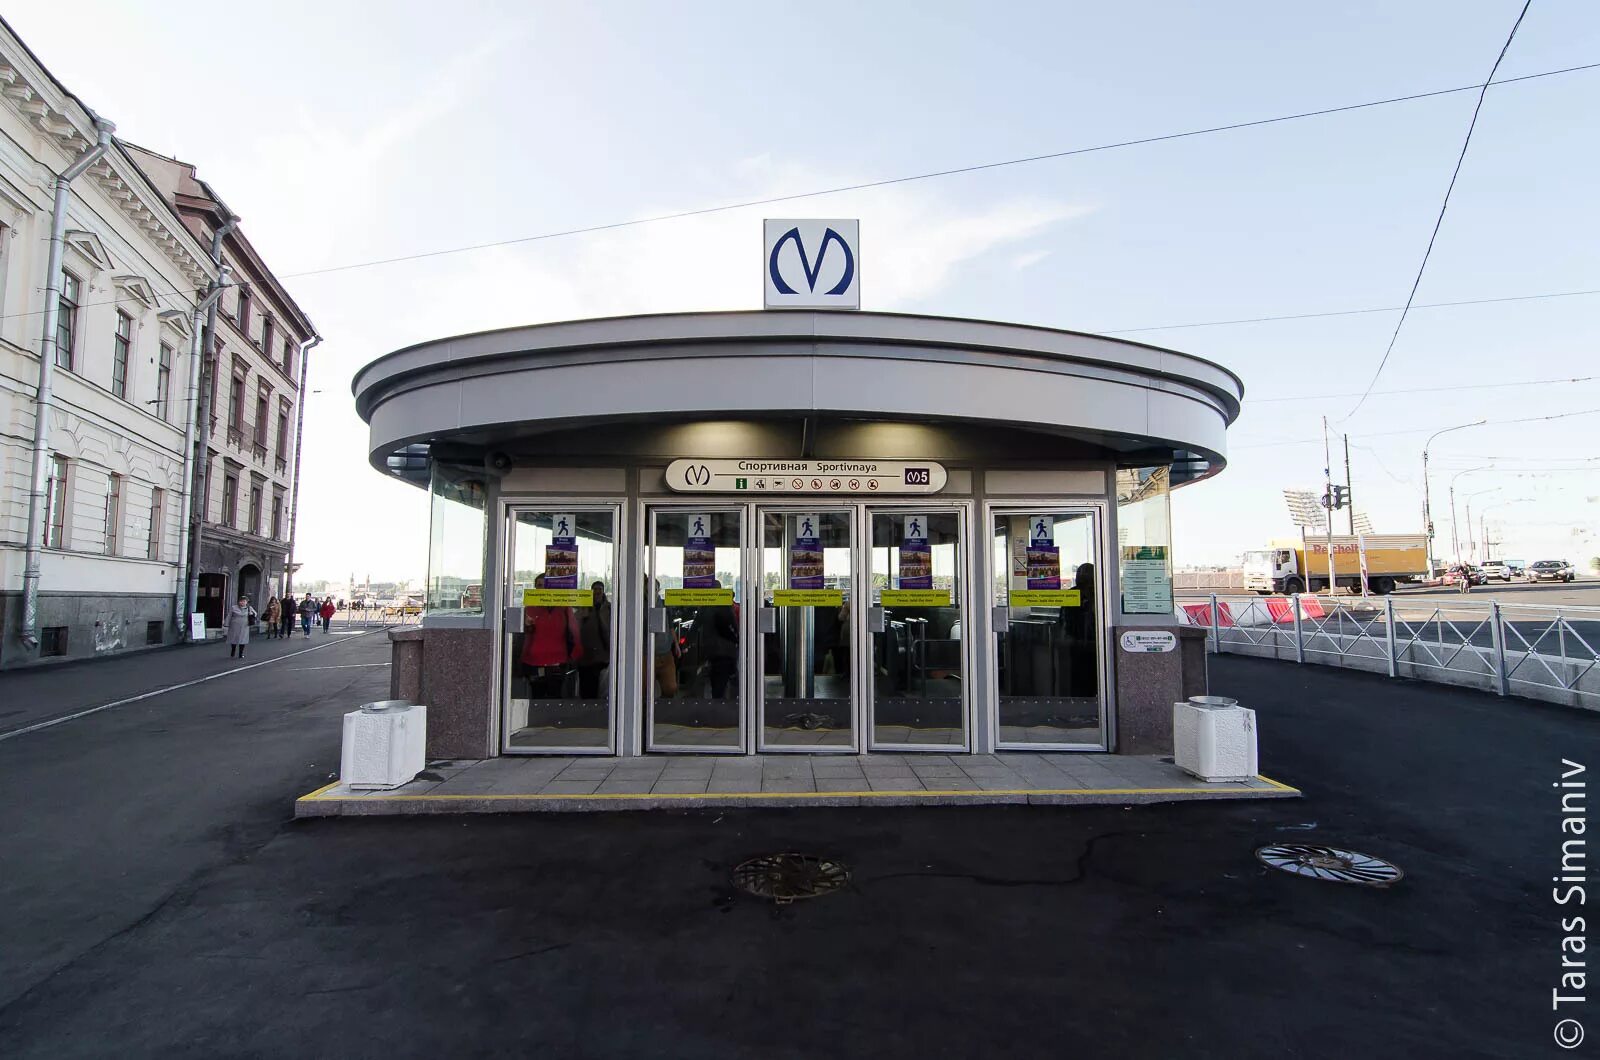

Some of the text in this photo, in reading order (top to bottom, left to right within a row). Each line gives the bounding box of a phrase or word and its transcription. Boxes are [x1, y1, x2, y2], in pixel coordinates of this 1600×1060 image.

[738, 461, 808, 473] Спортивная
[817, 462, 877, 474] Sportivnaya
[1313, 543, 1359, 555] Rechelt
